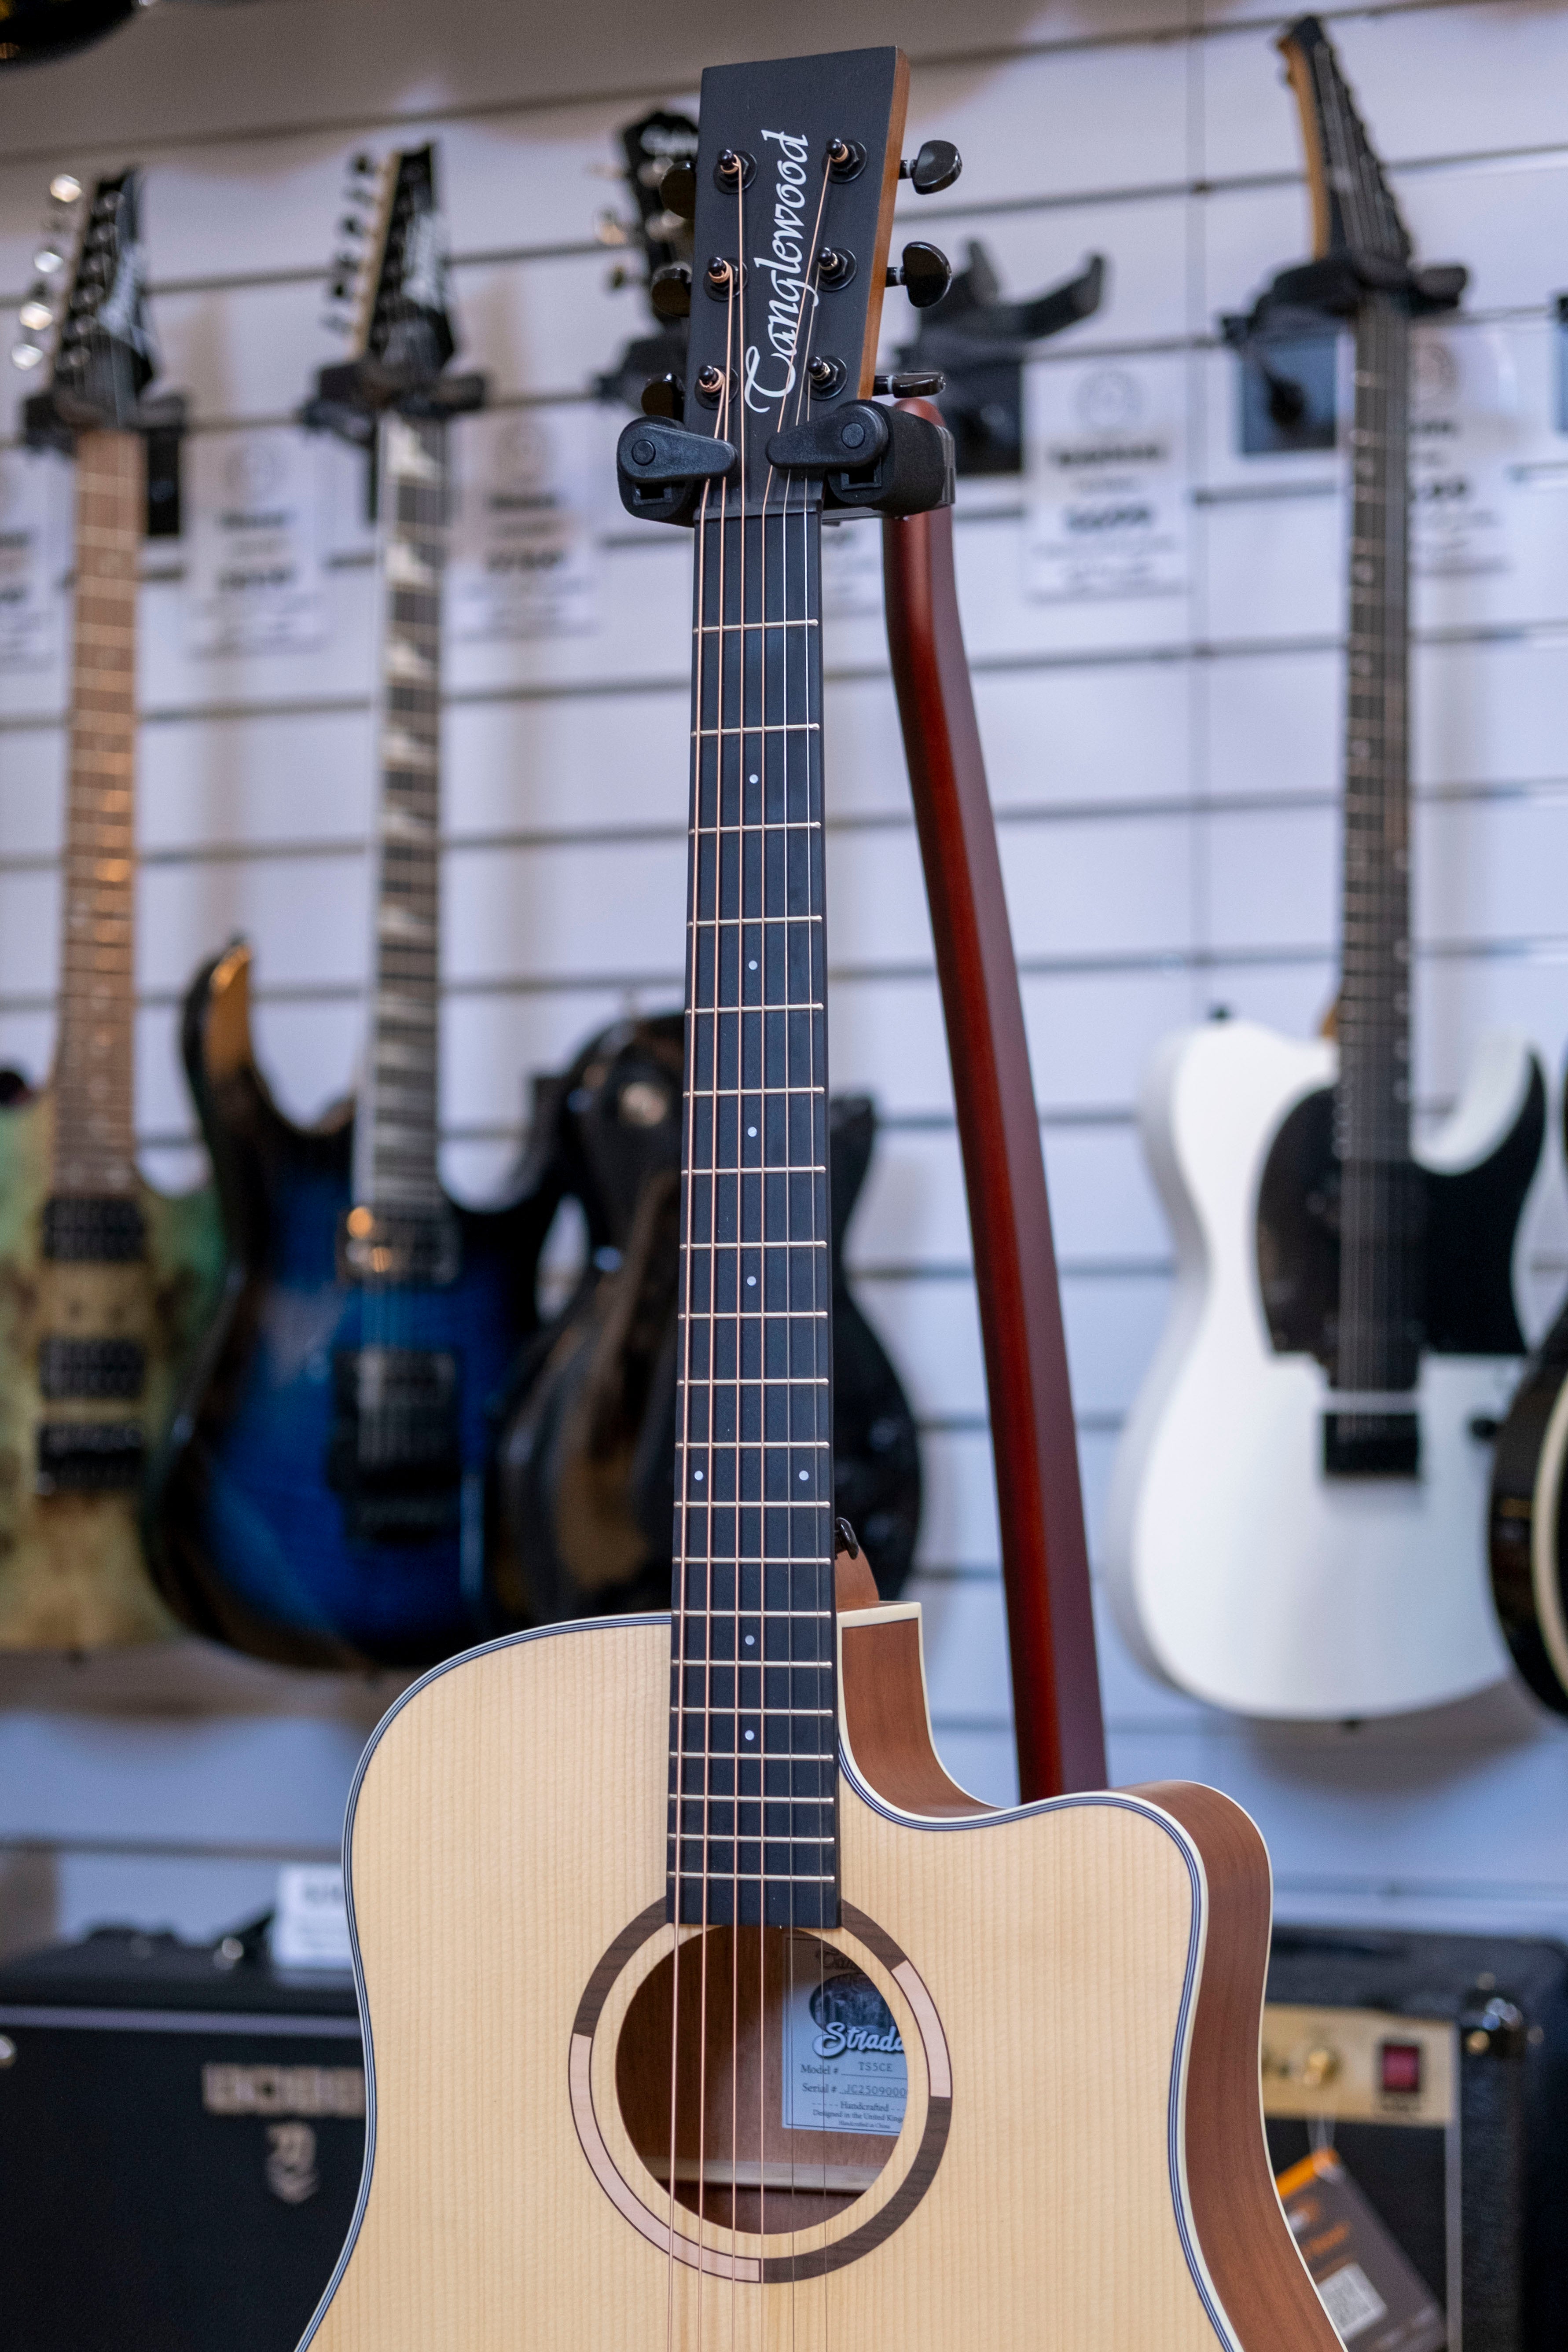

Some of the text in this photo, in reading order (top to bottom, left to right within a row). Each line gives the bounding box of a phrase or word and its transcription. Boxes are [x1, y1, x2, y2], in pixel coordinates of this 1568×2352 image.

[744, 129, 819, 414] Tanglewood
[800, 2064, 831, 2075] Model
[802, 2083, 829, 2093] Serial
[840, 2101, 889, 2112] Handcrafted
[813, 2109, 842, 2118] Designed
